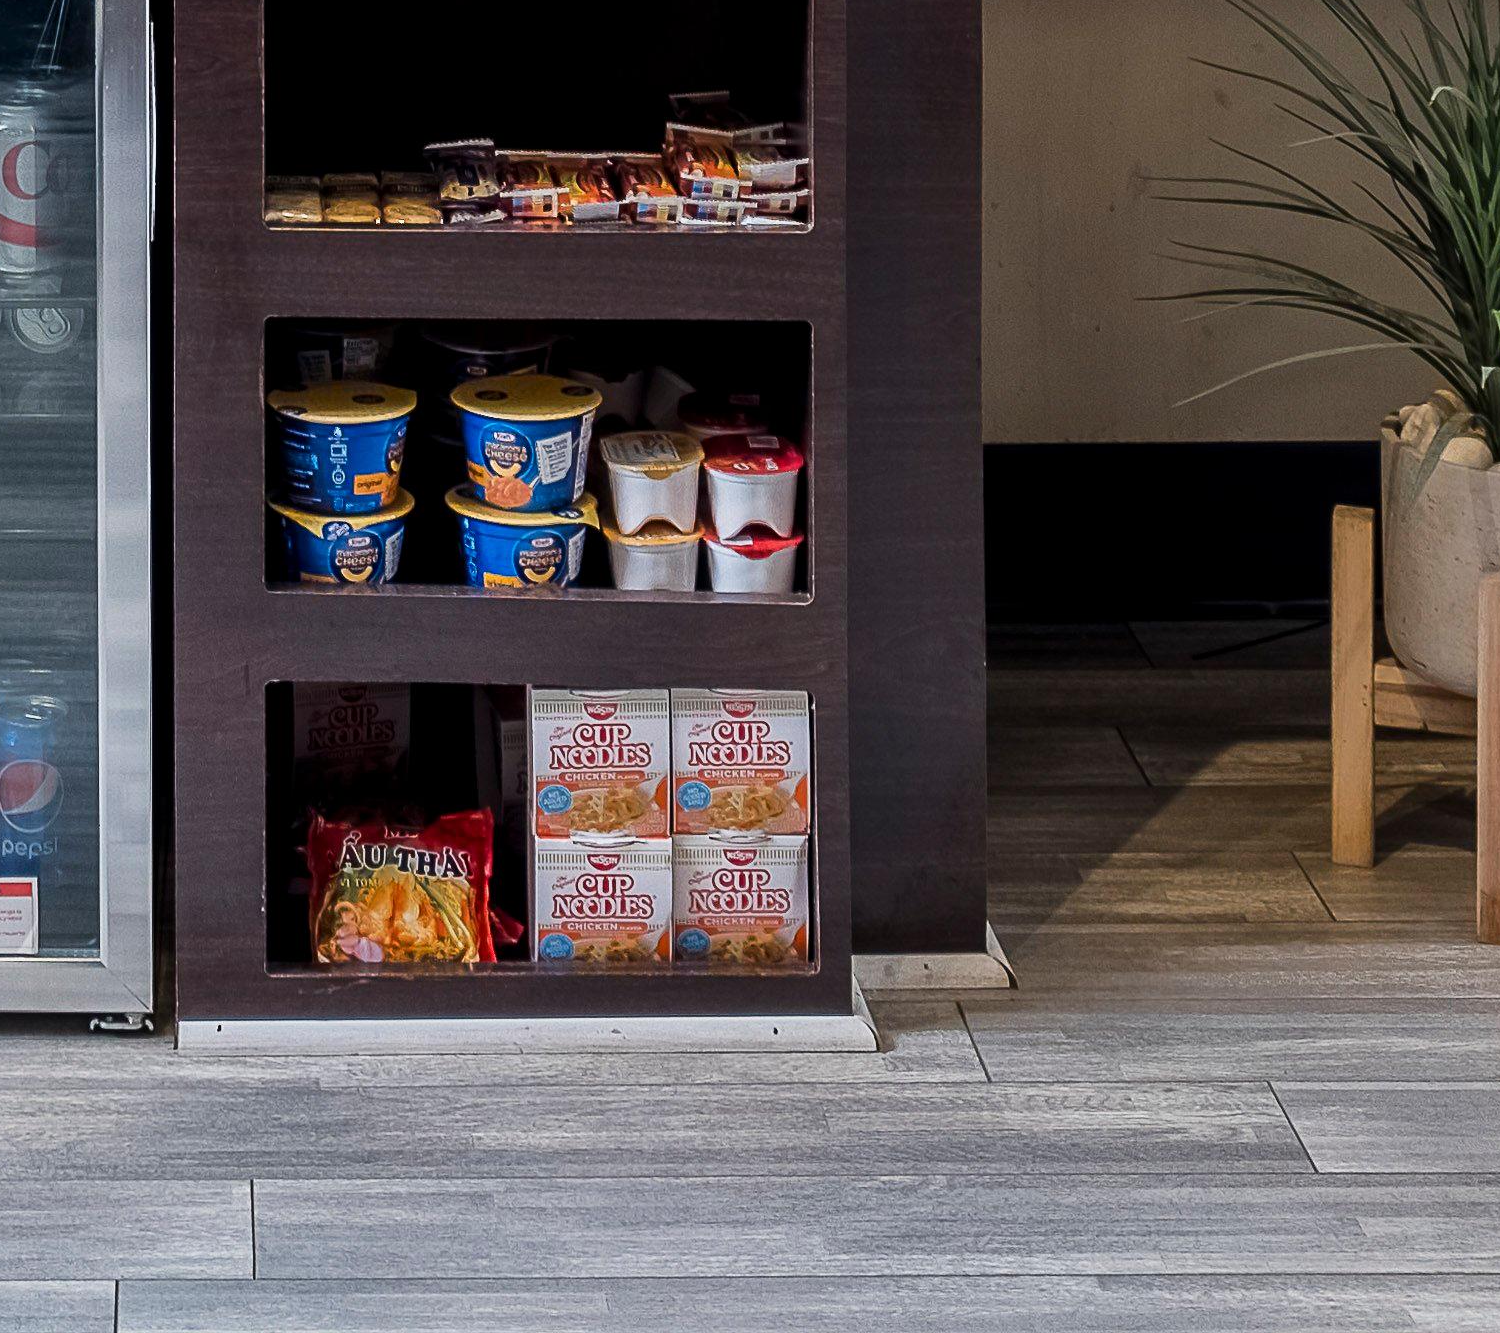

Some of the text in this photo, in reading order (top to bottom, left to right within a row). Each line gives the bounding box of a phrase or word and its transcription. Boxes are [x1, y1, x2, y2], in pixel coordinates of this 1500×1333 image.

[307, 722, 395, 751] NOODLES
[573, 723, 631, 747] CUP
[711, 720, 770, 744] CUP
[550, 744, 652, 769] NOODLES
[689, 741, 790, 766] NOODLES
[565, 772, 617, 781] CHICKEN
[704, 770, 756, 779] CHICKEN
[1, 837, 58, 860] pepsi
[575, 874, 634, 896] CUP
[712, 869, 771, 892] CUP
[552, 894, 654, 919] NOODLES
[689, 889, 791, 914] NOODLES
[567, 922, 618, 931] CHICKEN
[704, 917, 756, 927] CHICKEN
